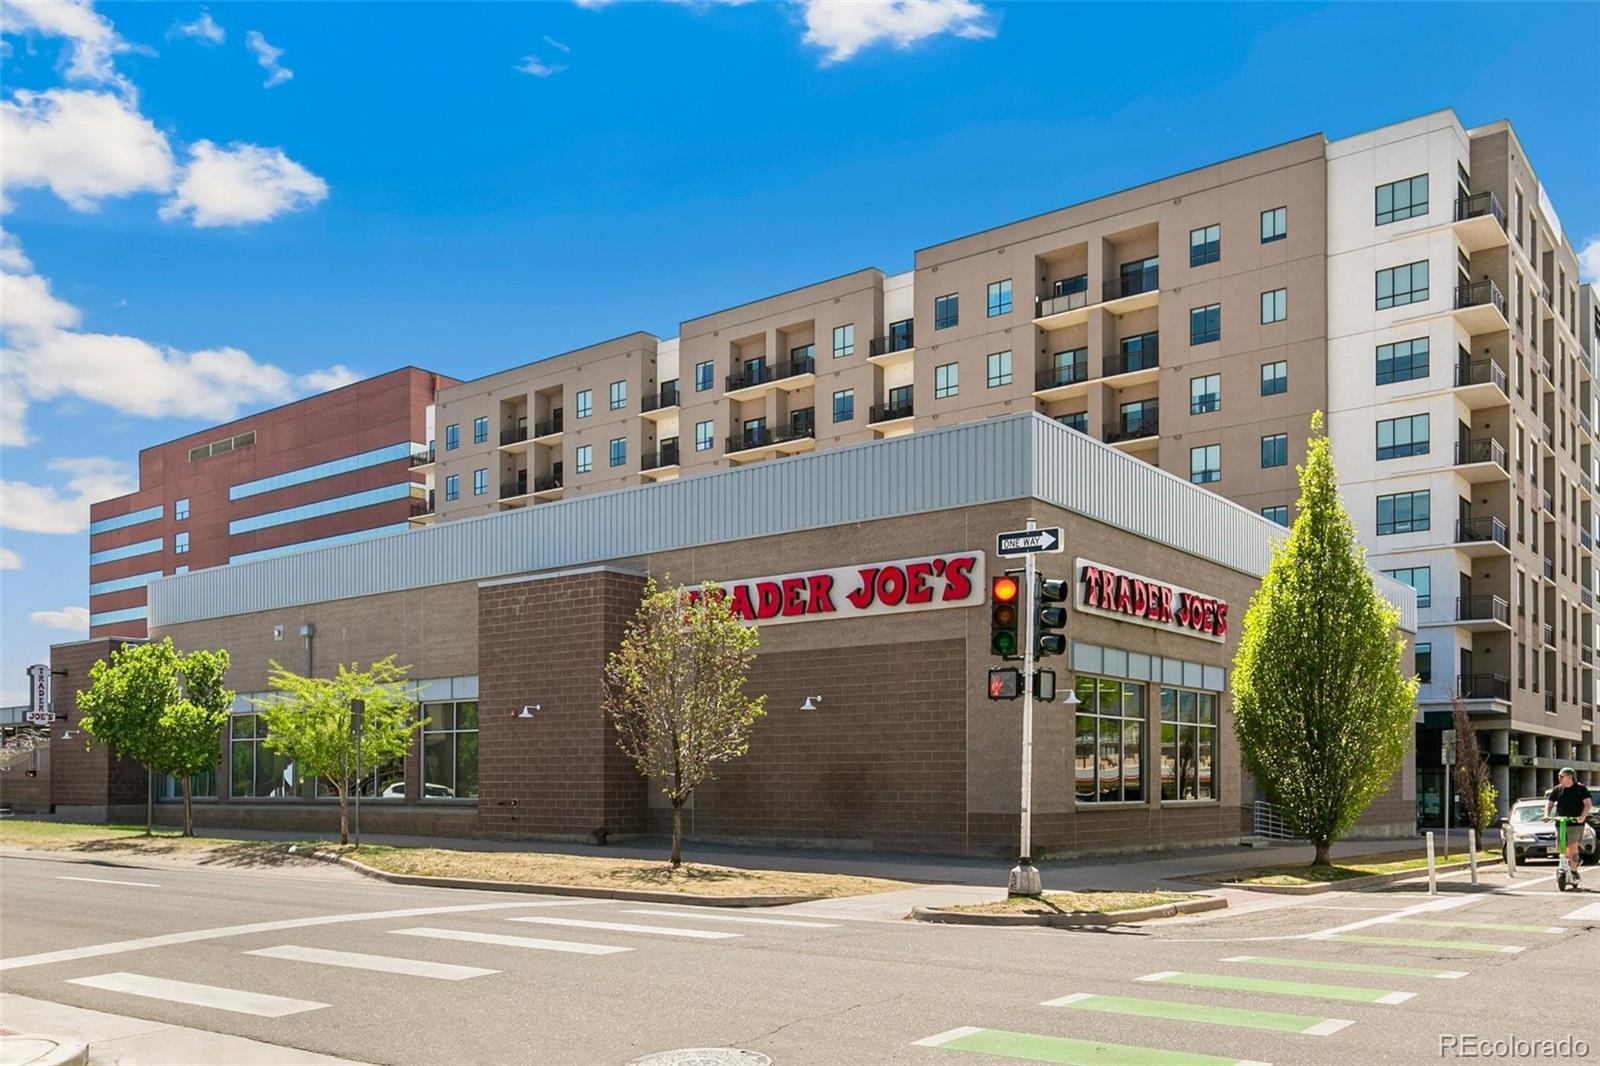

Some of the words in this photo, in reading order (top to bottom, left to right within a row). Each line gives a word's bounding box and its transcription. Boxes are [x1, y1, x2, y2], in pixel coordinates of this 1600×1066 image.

[1003, 540, 1020, 549] ONE
[1023, 537, 1040, 547] WAY
[680, 574, 837, 624] ADER
[846, 557, 977, 610] JOE'S
[1081, 566, 1174, 624] TRADER
[1174, 592, 1229, 637] JOE'S
[28, 712, 54, 721] JOE'S
